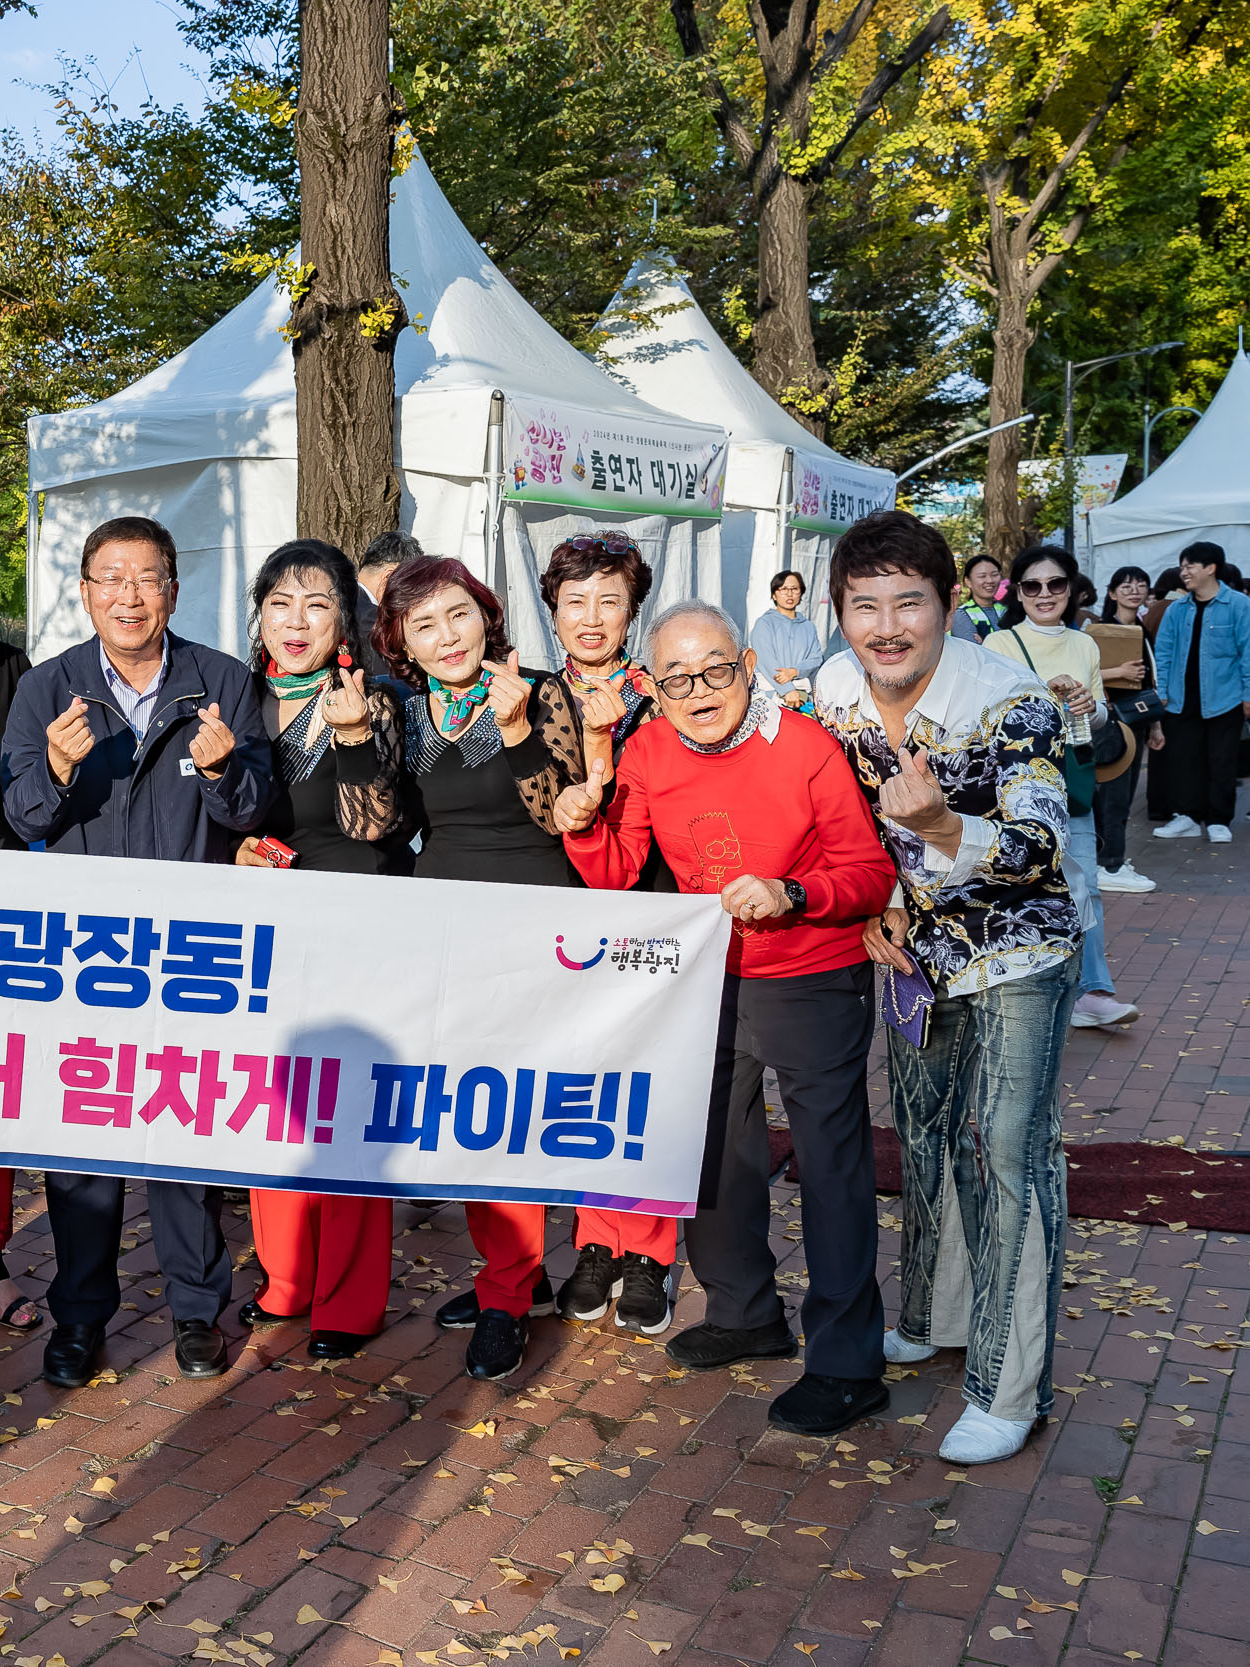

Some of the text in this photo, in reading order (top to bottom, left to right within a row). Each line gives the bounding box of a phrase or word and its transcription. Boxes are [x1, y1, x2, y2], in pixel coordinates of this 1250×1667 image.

[590, 450, 698, 499] 출연자 대기실
[830, 489, 855, 523] 출연자
[610, 949, 680, 974] 행복광진
[613, 938, 681, 951] 소통하며 발전하는
[58, 1037, 341, 1145] 힘차게!
[363, 1062, 651, 1161] 파이팅!
